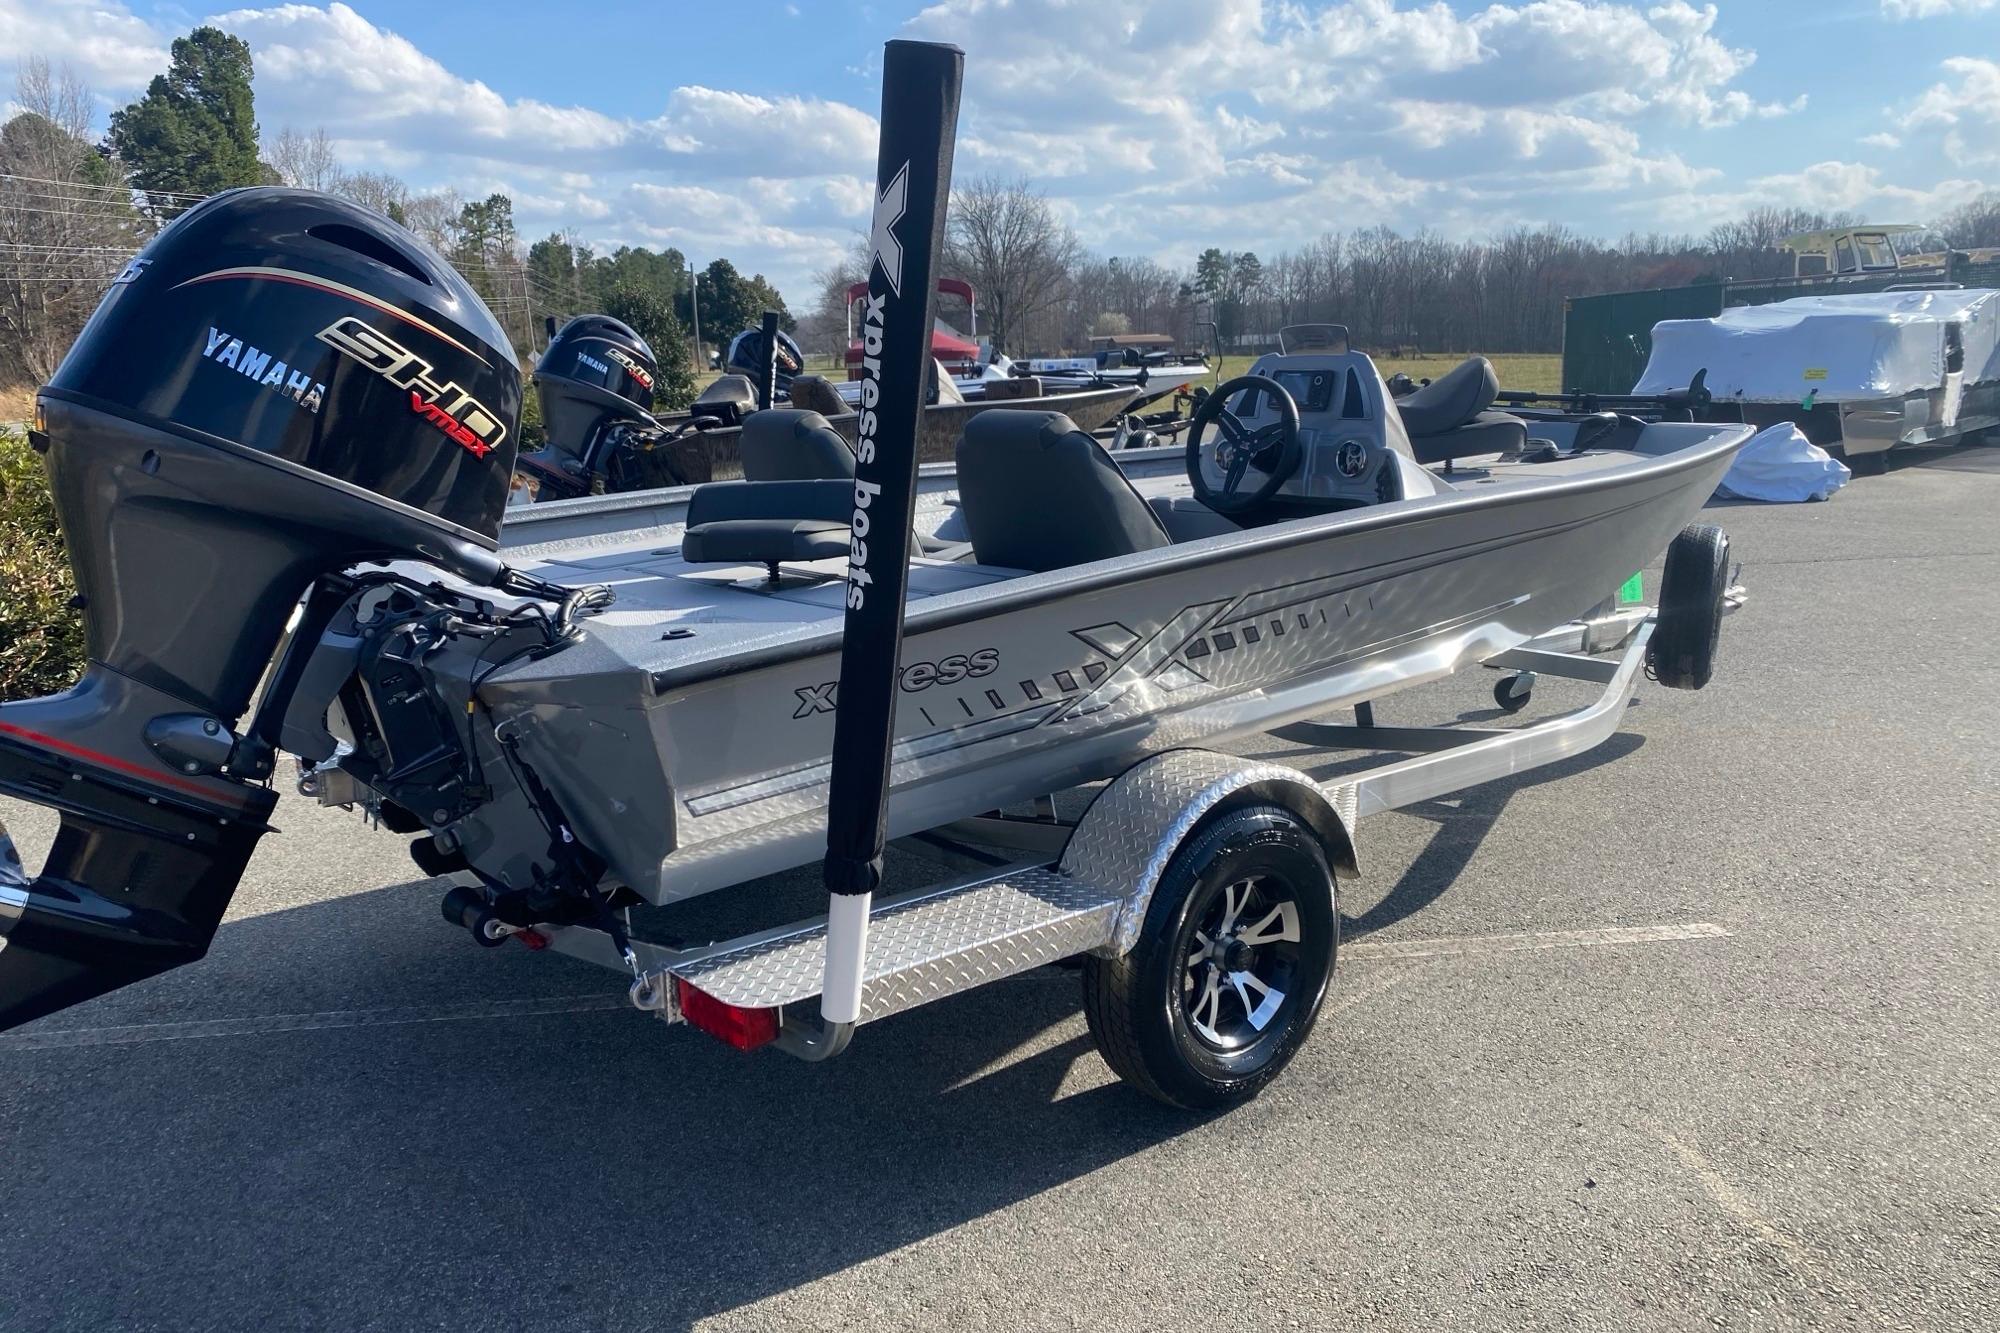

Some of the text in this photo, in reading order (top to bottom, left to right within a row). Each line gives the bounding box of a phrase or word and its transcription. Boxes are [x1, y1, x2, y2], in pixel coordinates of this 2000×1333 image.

[202, 326, 326, 414] YAMAHA
[577, 351, 609, 375] YAMAHA
[847, 289, 886, 612] xpress boats
[793, 648, 999, 719] xess
